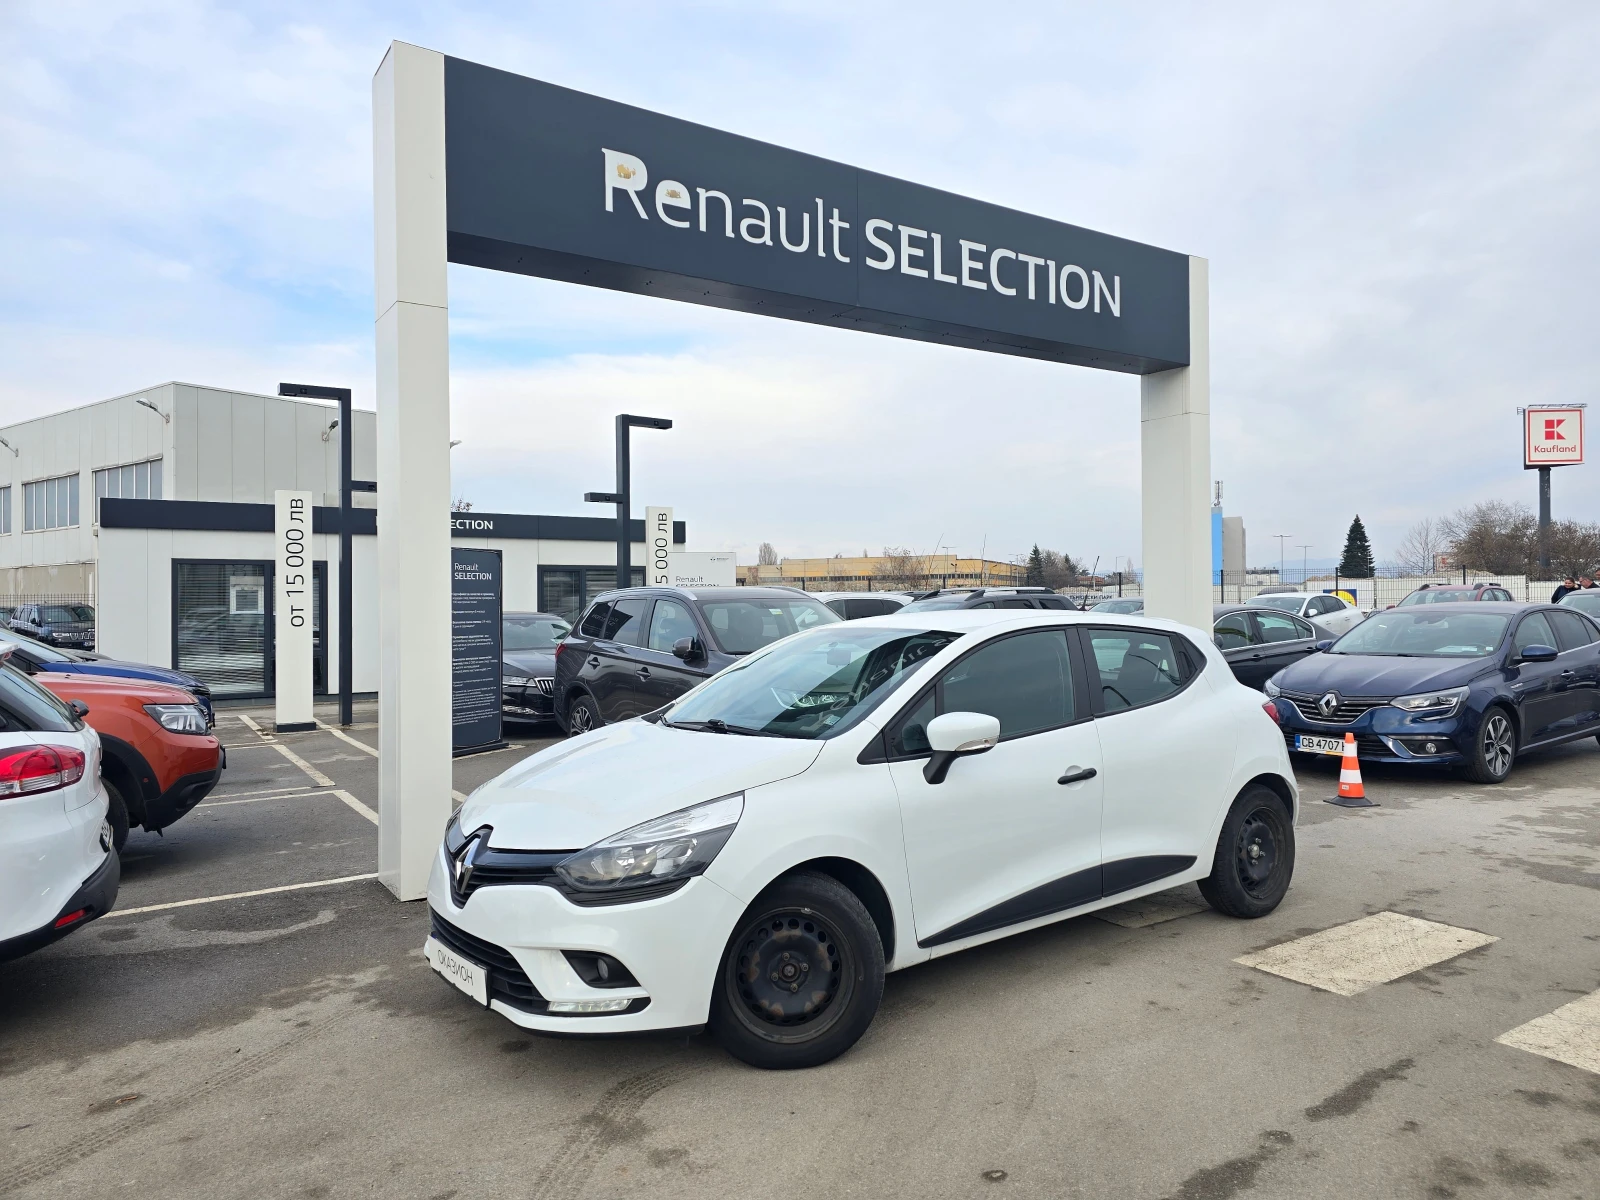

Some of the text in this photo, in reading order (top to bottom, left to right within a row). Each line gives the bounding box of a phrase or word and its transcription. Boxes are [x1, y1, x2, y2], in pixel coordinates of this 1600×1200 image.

[601, 147, 1121, 318] Renault SELECTION
[1534, 445, 1576, 453] Kaufland
[285, 528, 305, 568] 000
[654, 537, 669, 570] 000
[454, 562, 479, 571] Renault
[454, 572, 492, 580] SELECTION
[675, 575, 704, 583] Renault
[285, 574, 305, 598] 15
[1316, 739, 1340, 751] 4707
